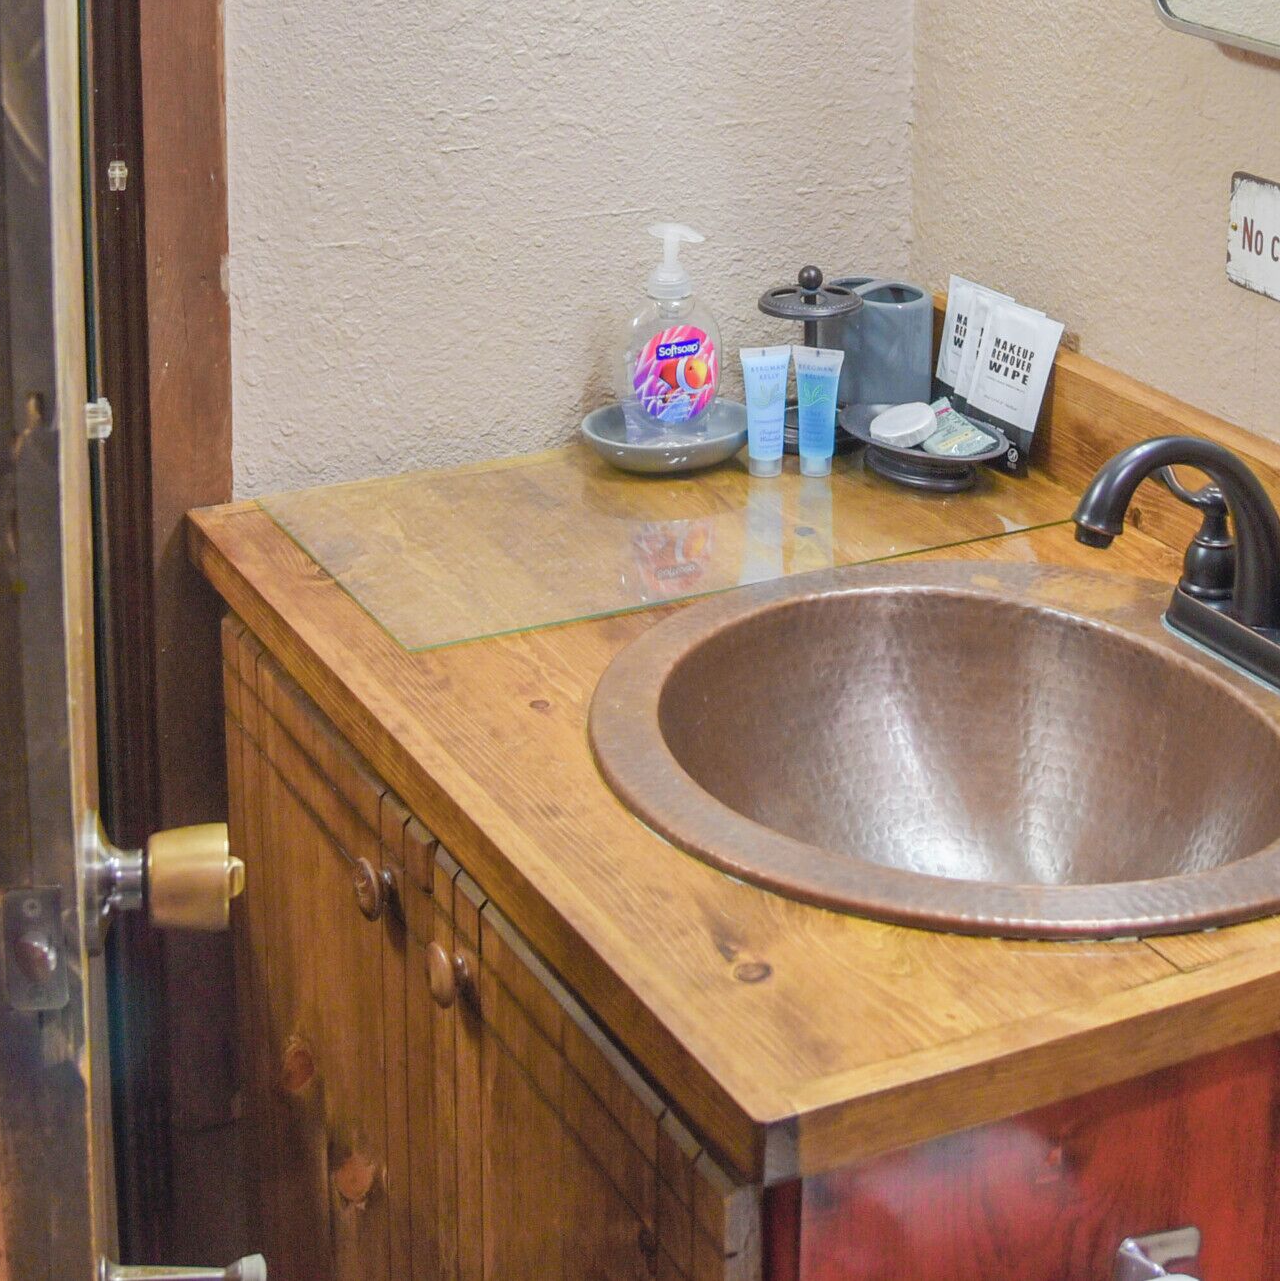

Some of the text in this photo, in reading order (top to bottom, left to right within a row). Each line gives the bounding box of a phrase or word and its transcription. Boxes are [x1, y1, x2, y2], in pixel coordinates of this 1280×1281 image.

[1241, 216, 1264, 256] No
[658, 342, 699, 358] Softsoap
[991, 348, 1032, 374] REMOVER
[994, 337, 1035, 361] MAKEUP
[988, 360, 1030, 386] WIPE
